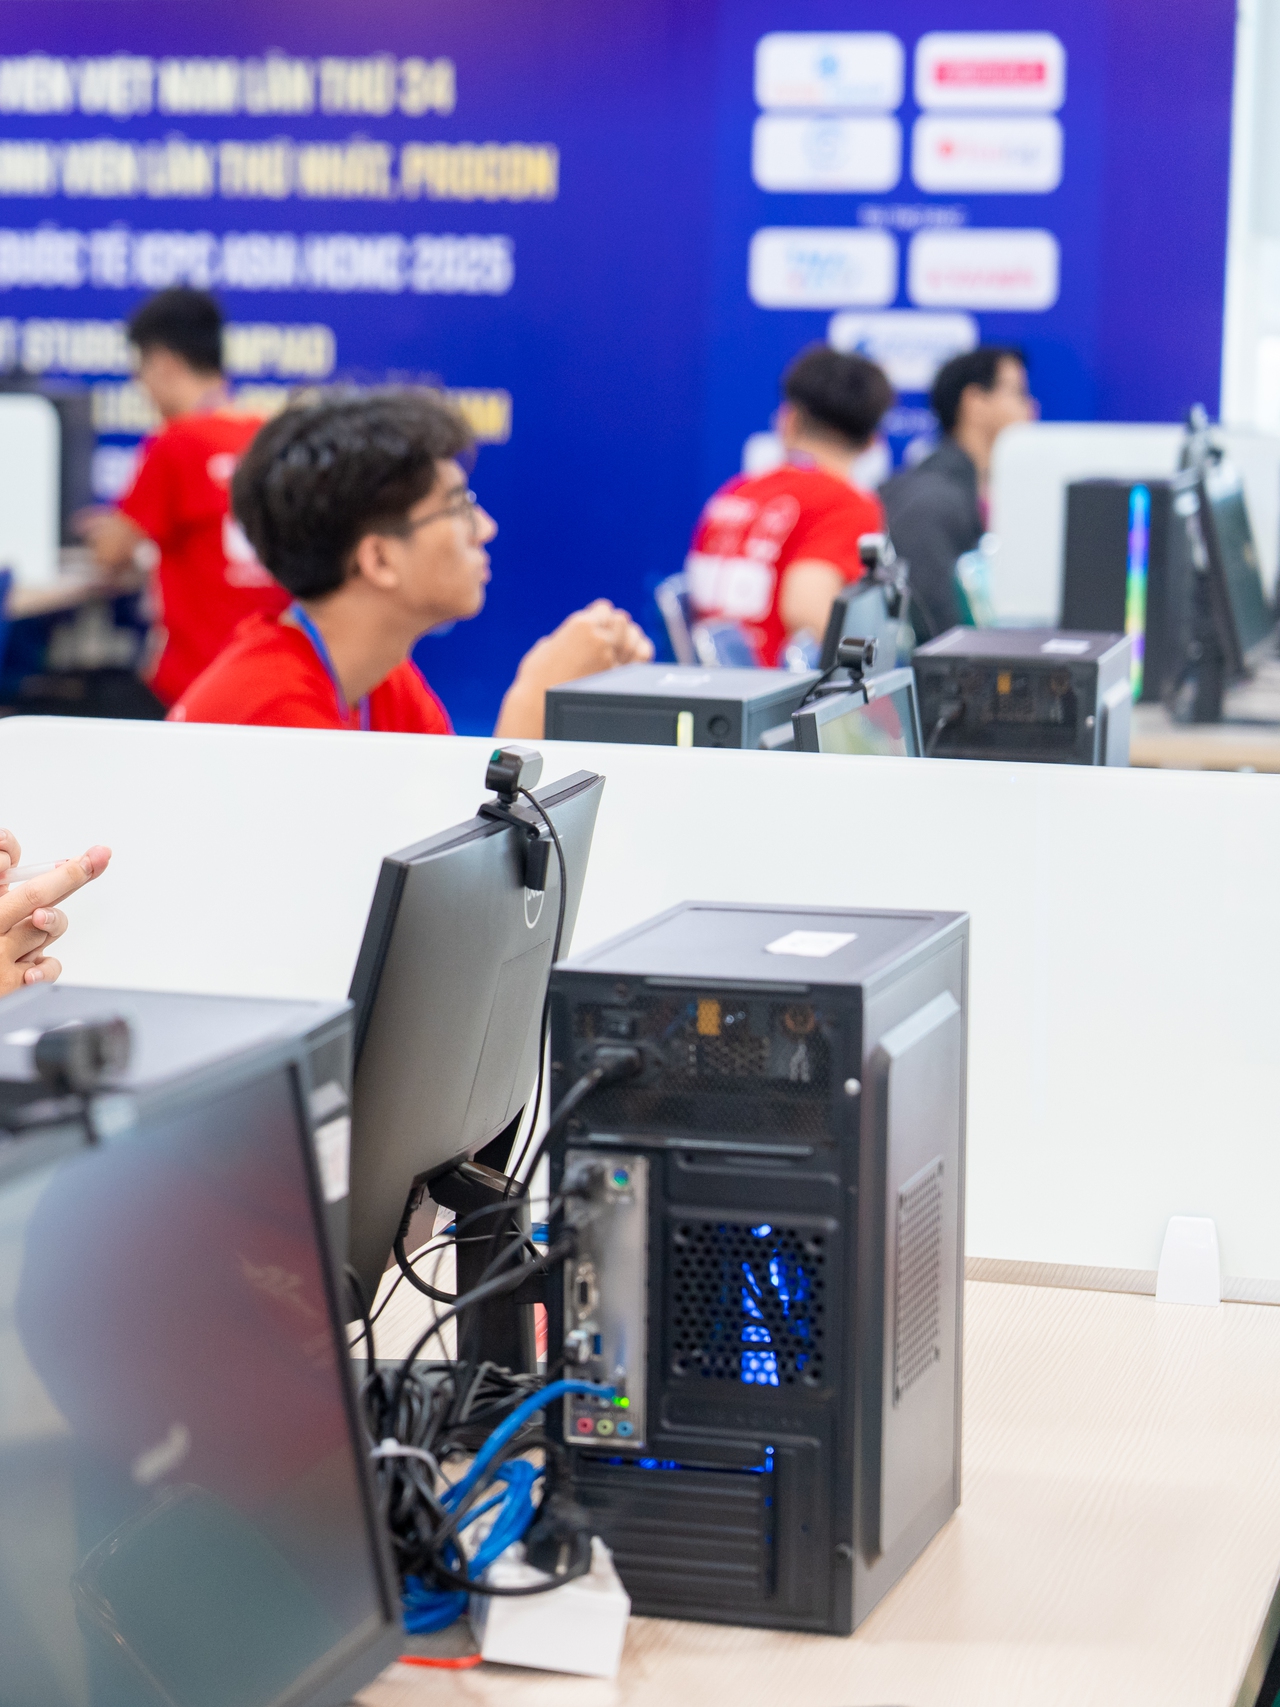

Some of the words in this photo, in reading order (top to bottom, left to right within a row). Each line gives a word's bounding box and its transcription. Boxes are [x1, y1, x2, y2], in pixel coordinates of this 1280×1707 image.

[401, 58, 455, 113] 34
[401, 143, 559, 199] PROCON
[410, 236, 513, 292] 2025
